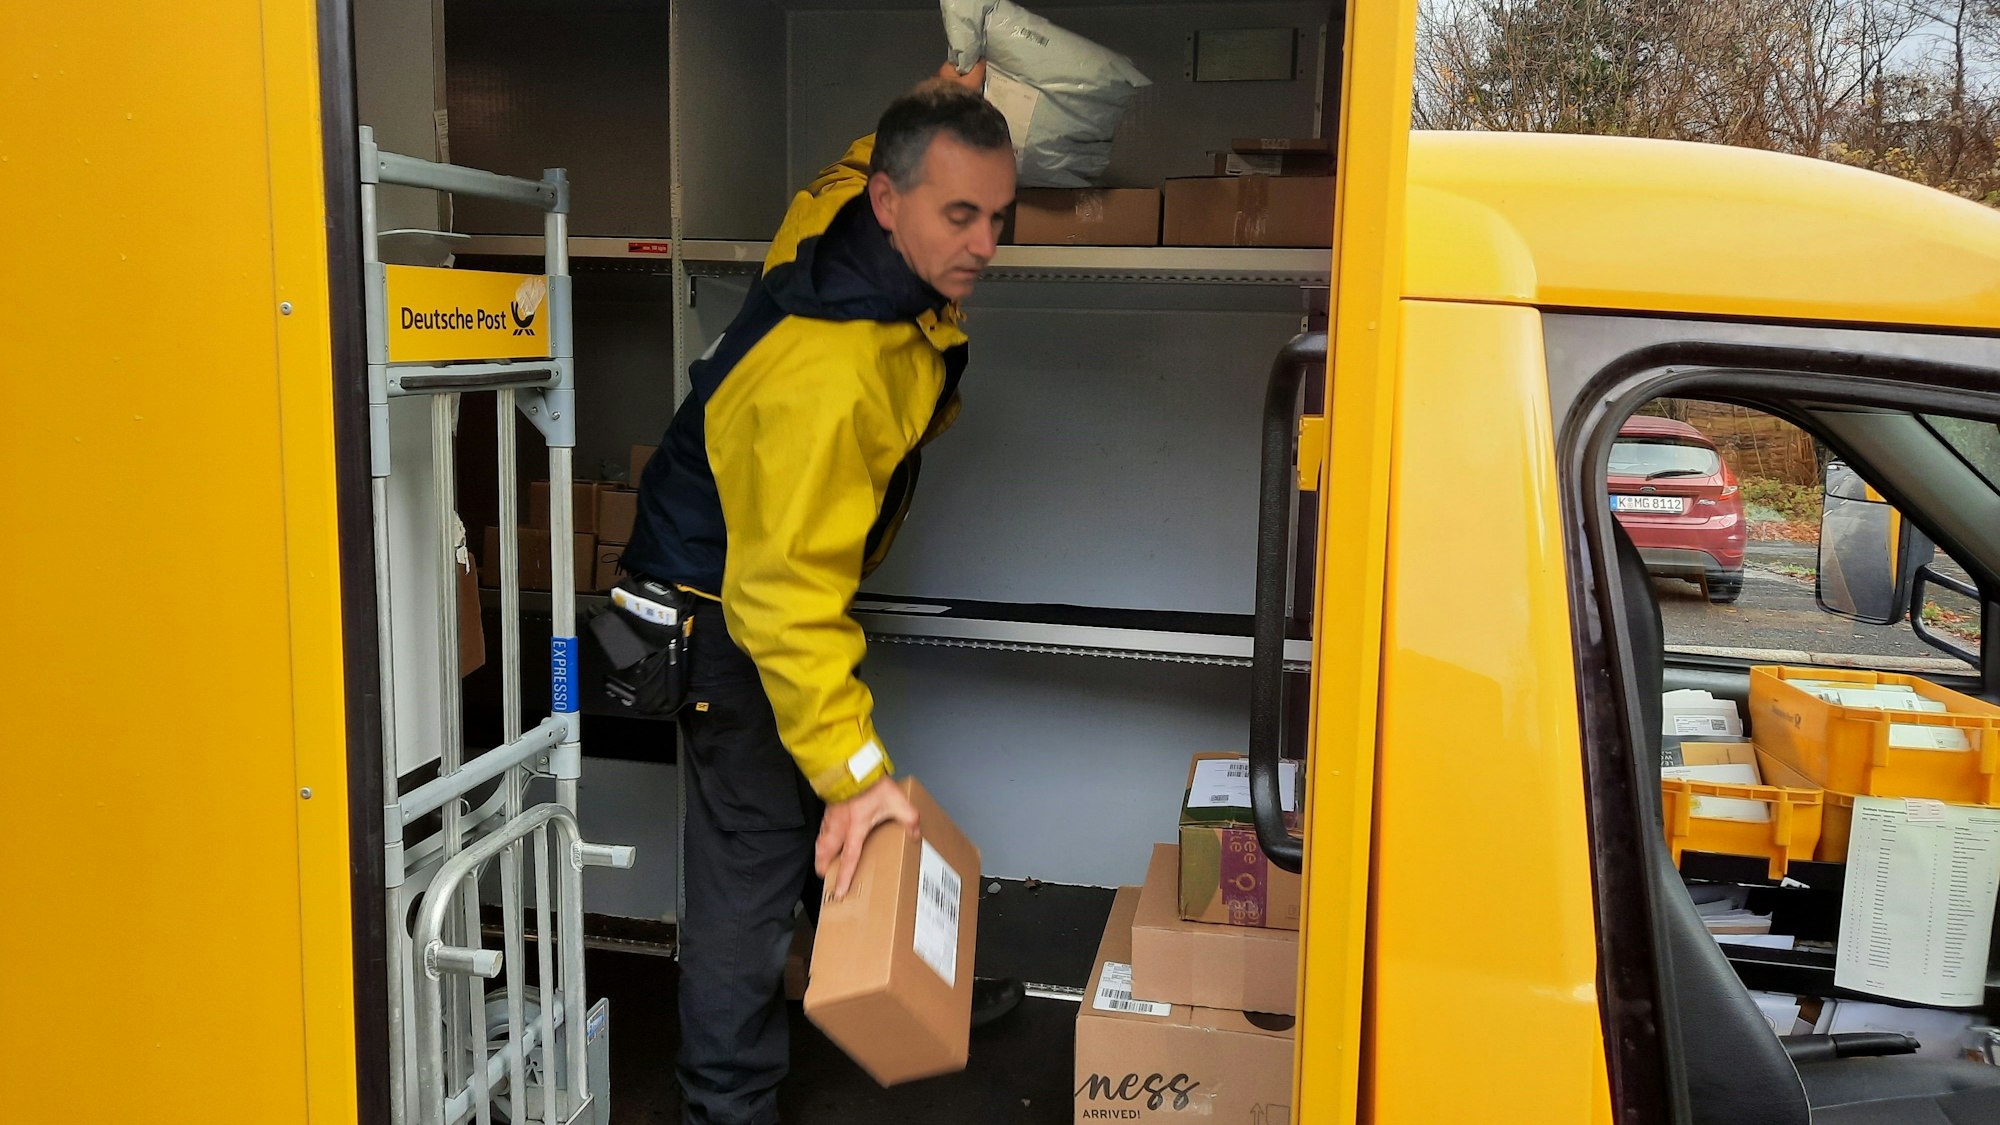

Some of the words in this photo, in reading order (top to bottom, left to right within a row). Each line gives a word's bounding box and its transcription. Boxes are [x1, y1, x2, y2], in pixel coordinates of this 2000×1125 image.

[401, 306, 474, 330] Deutsche
[477, 308, 507, 330] Post
[1618, 497, 1626, 508] K
[1634, 497, 1650, 508] MG
[1652, 498, 1682, 510] 8112
[552, 640, 568, 711] EXPRESSO
[1074, 1072, 1201, 1112] ness
[1082, 1109, 1141, 1120] ARRIVED!
